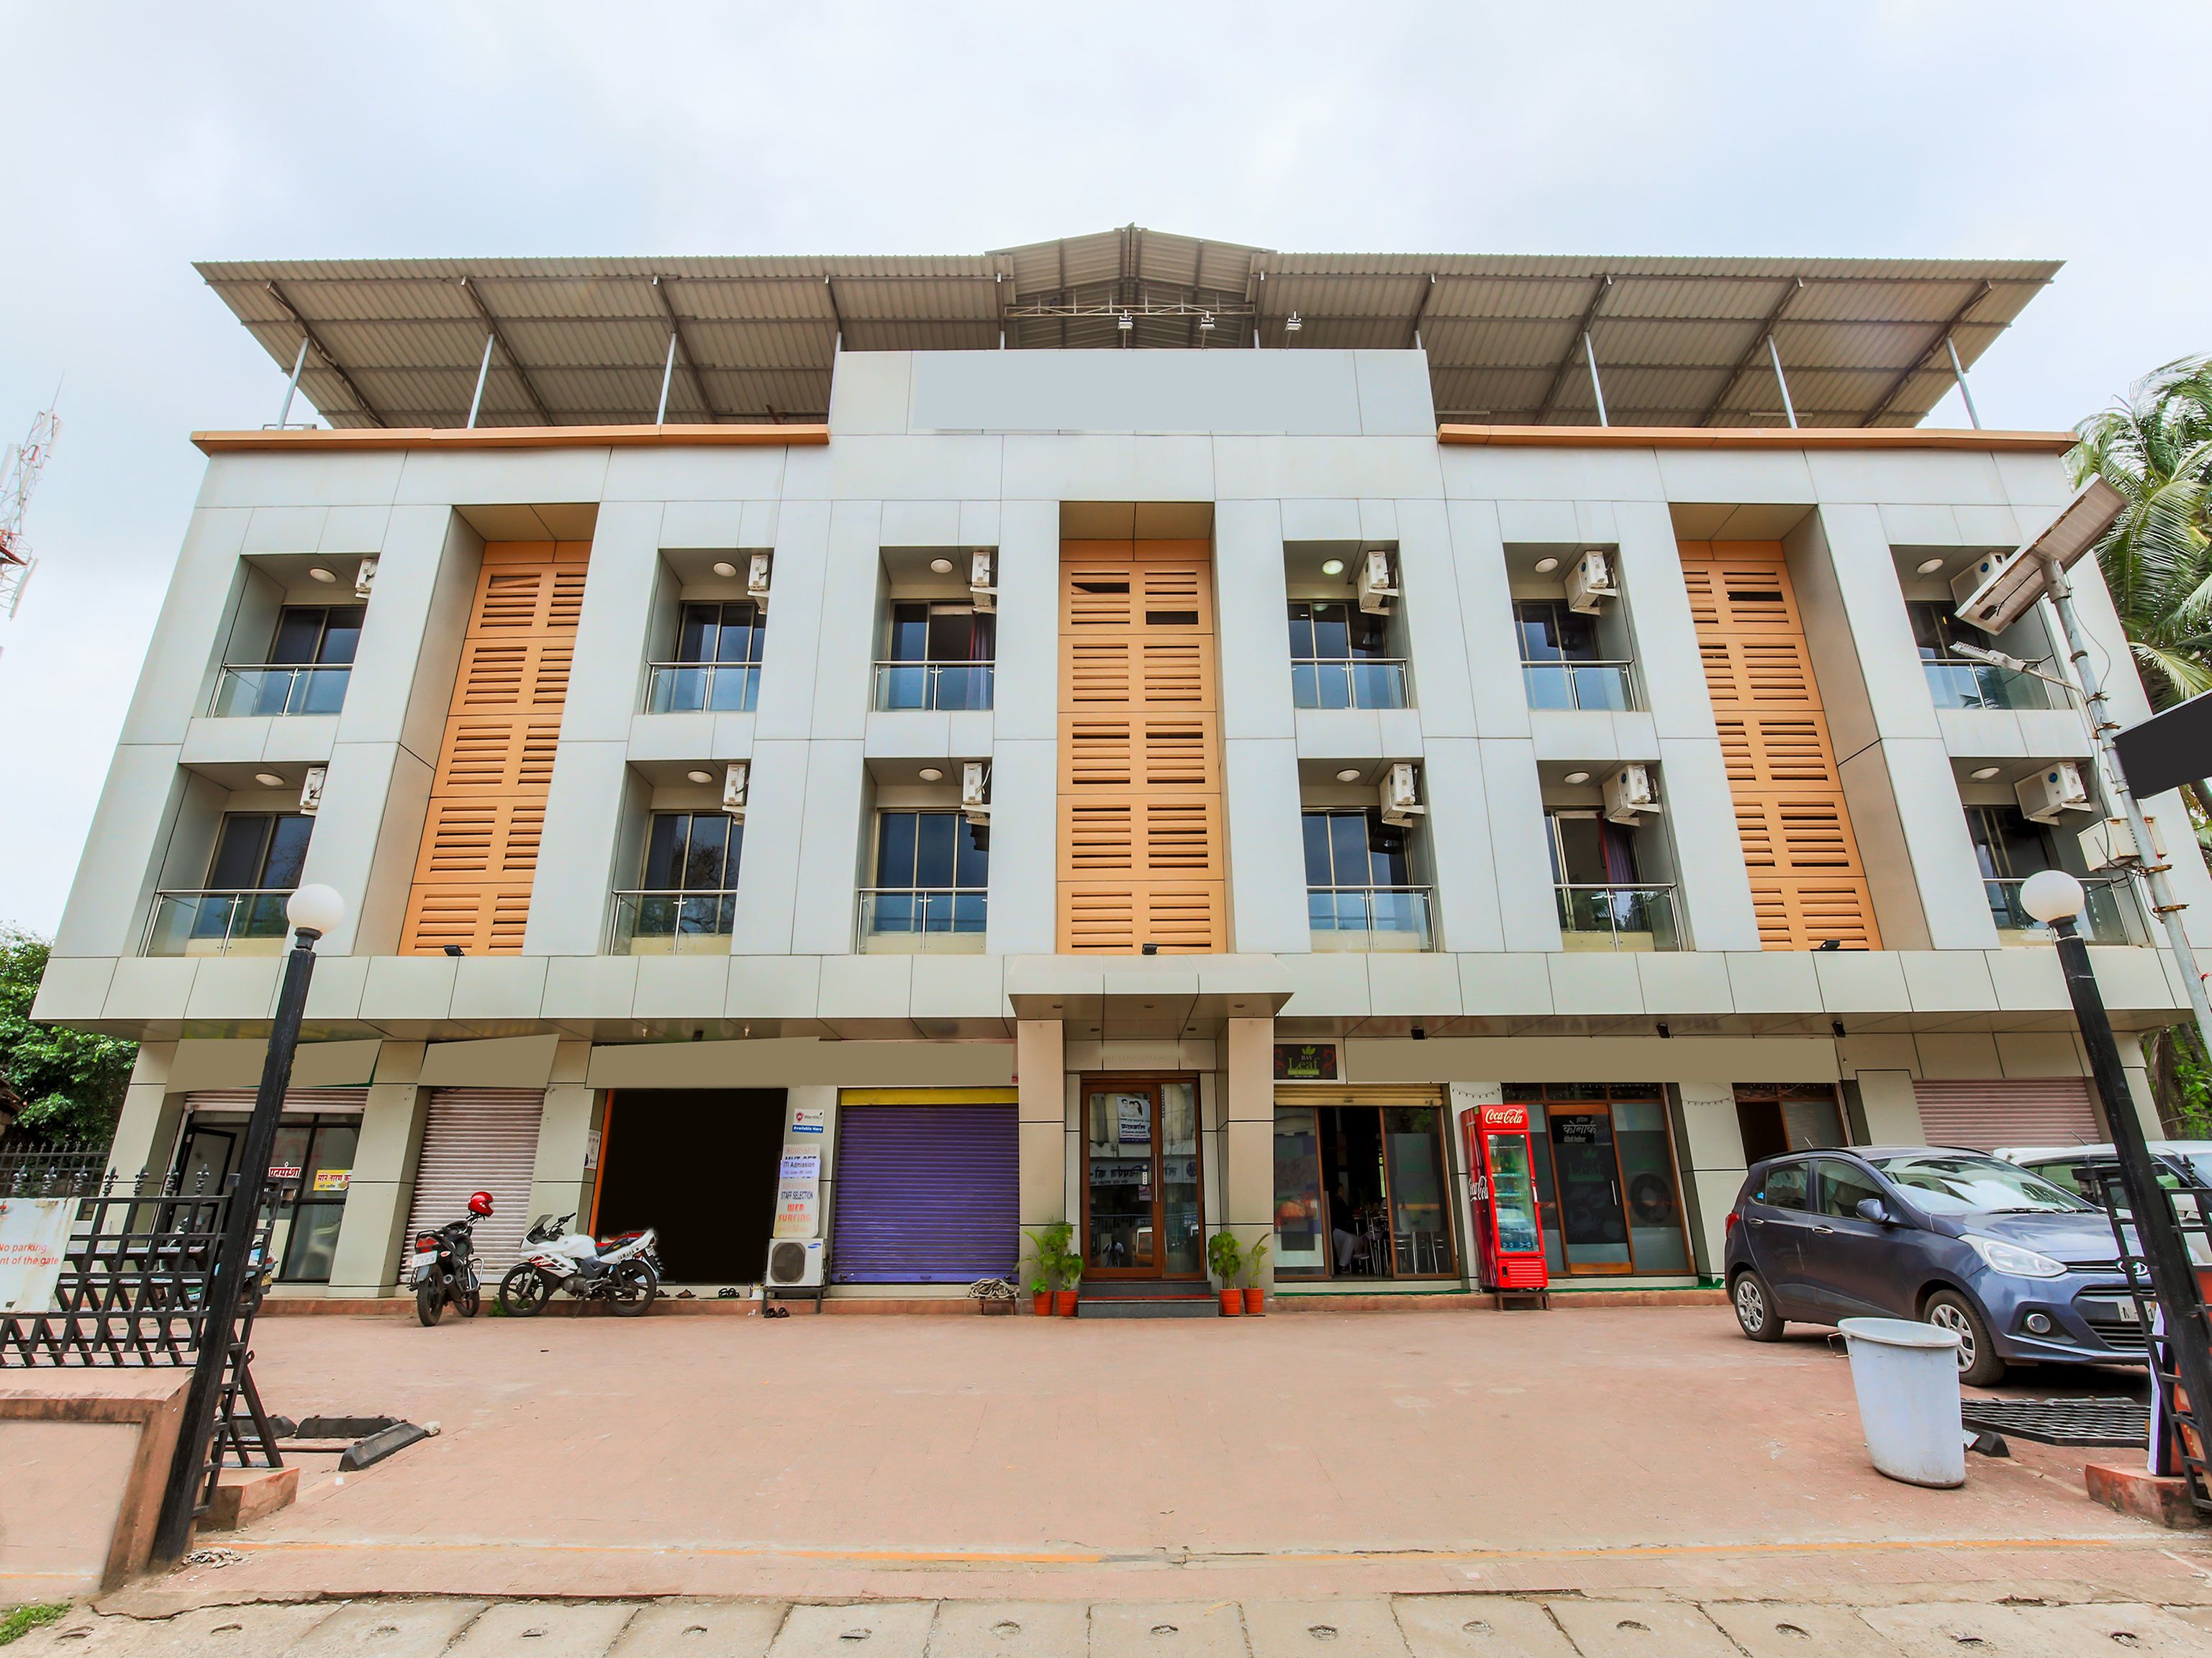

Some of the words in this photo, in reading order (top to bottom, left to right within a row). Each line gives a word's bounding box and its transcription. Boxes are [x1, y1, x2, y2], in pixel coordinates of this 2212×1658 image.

[1287, 1056, 1320, 1070] Leaf
[1485, 1108, 1524, 1124] Coca-Cola
[1562, 1120, 1597, 1134] कोनार्क
[792, 1191, 813, 1200] SELECTION
[12, 1243, 47, 1254] parking
[12, 1256, 22, 1264] of
[23, 1256, 38, 1264] the
[40, 1256, 59, 1267] gate
